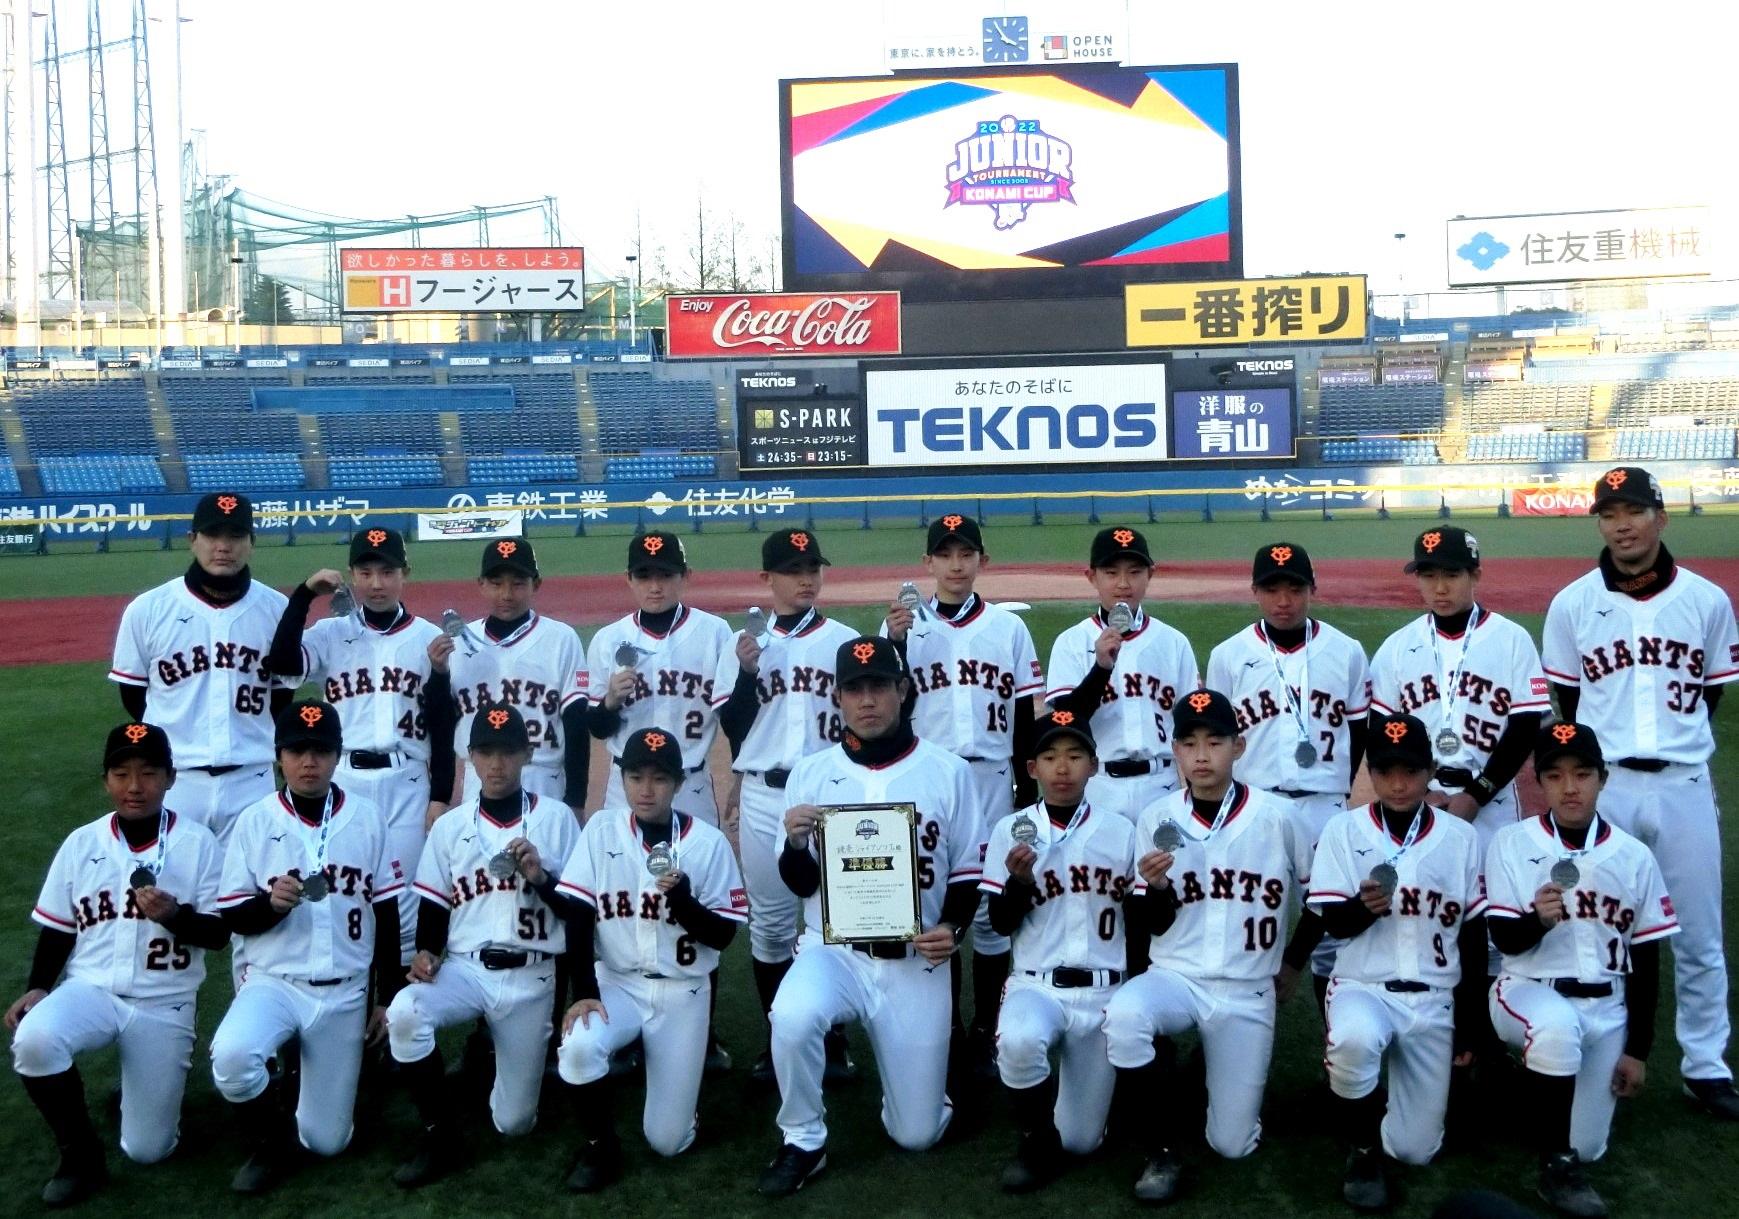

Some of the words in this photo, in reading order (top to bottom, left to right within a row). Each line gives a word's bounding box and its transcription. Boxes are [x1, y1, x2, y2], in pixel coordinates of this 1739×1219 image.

[1073, 35, 1112, 46] OPEN
[1074, 47, 1112, 58] HOUSE
[948, 132, 1071, 182] JUNIOR
[973, 169, 1047, 182] TOURNAMENT
[964, 187, 1021, 201] KONAMI
[1023, 186, 1055, 200] CUP
[347, 252, 581, 268] 欲しかった暮らしを、しよう。
[416, 275, 579, 305] フージャース
[679, 299, 714, 312] Enjoy
[712, 297, 878, 348] Coca-Cola
[1140, 285, 1350, 339] 一番搾り
[1236, 359, 1294, 371] TEKNOS
[741, 377, 796, 388] TEKNOS
[954, 378, 1073, 396] あなたのそばに
[780, 407, 851, 428] S-PARK
[1199, 395, 1264, 415] 洋服の
[750, 434, 857, 446] スポーツニュースはフジテレビ
[877, 403, 1157, 453] TEKNOS
[1196, 418, 1269, 453] 青山
[682, 486, 795, 516] 住友化学
[158, 641, 272, 686] GIANTS
[1582, 635, 1705, 683] GIANTS
[912, 658, 1015, 700] IANTS
[1101, 672, 1176, 711] ANTS
[235, 684, 267, 715] 65
[456, 678, 560, 717] IANTS
[1667, 681, 1704, 714] 37
[397, 709, 428, 741] 49
[685, 710, 705, 739] 2
[817, 711, 842, 743] 18
[986, 702, 1008, 733] 19
[1154, 712, 1167, 743] 5
[1320, 731, 1335, 761] 7
[1462, 714, 1501, 753] 55
[348, 907, 362, 940] 8
[517, 907, 548, 940] 51
[1098, 907, 1116, 940] 0
[1243, 916, 1278, 951] 10
[146, 937, 191, 970] 25
[675, 935, 697, 966] 6
[1432, 933, 1447, 967] 9
